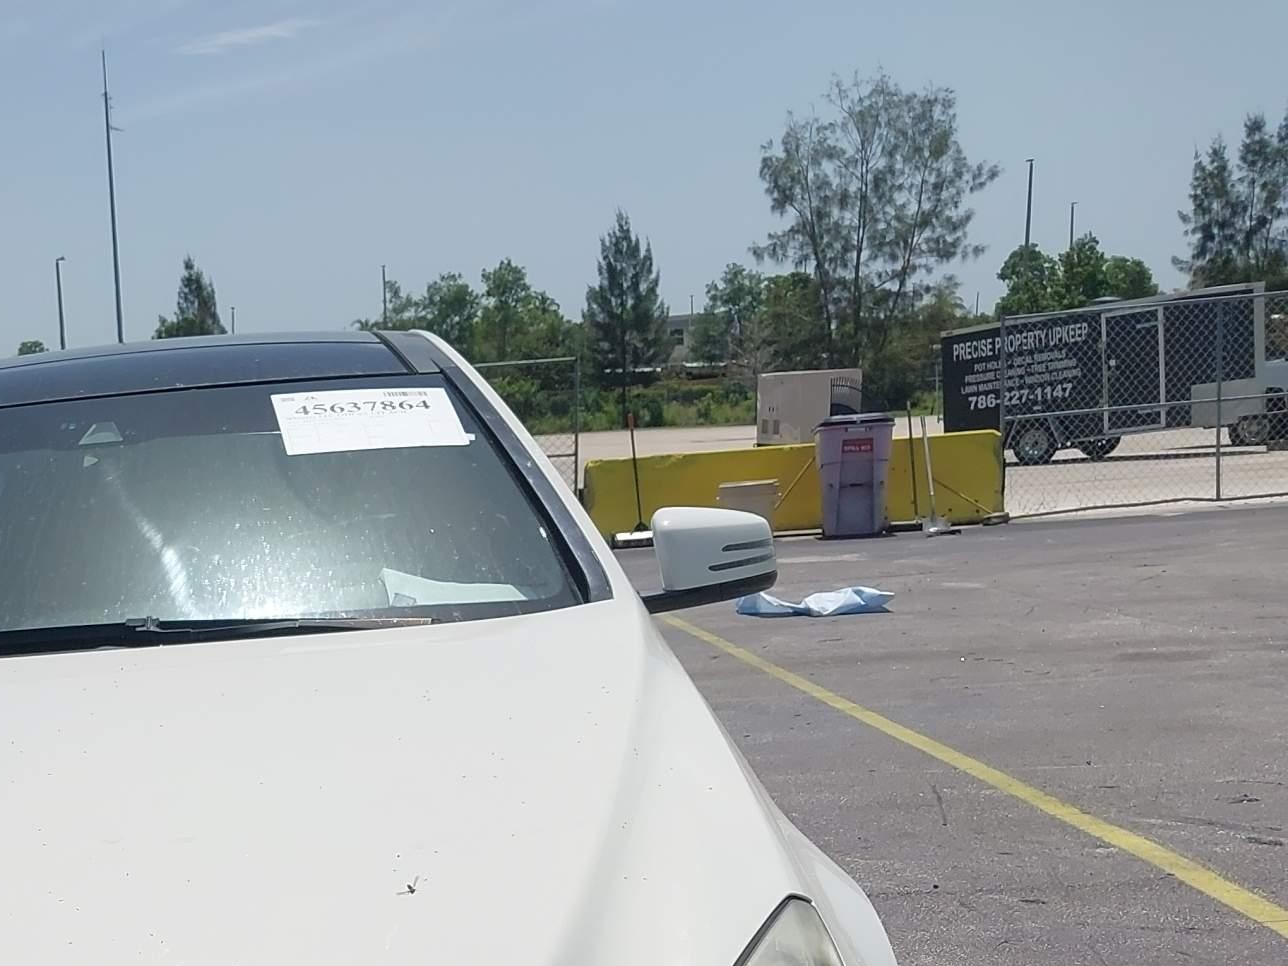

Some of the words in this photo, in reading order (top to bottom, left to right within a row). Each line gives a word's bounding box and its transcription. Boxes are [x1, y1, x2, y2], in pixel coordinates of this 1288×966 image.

[953, 338, 993, 361] PRECISE
[1049, 322, 1089, 346] UPKEEP
[974, 362, 986, 372] POT
[295, 399, 431, 416] 45637864
[968, 383, 1072, 410] 786-227-1147
